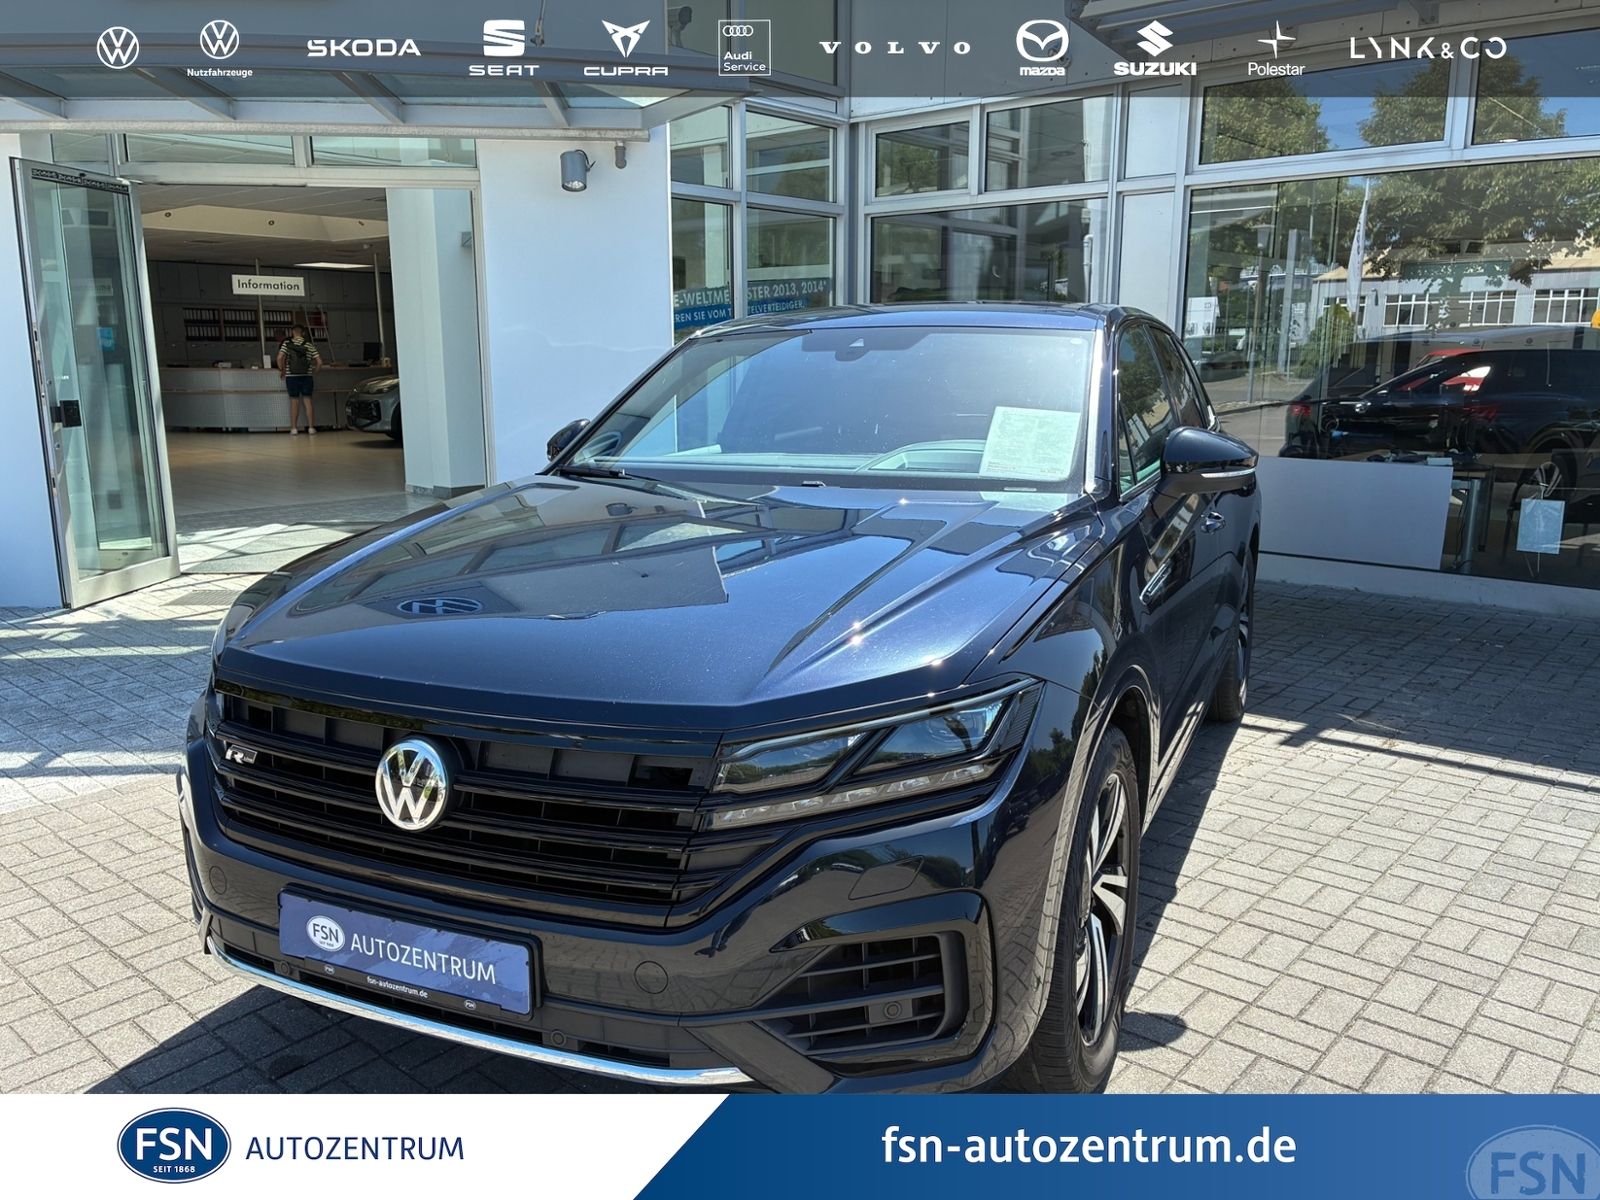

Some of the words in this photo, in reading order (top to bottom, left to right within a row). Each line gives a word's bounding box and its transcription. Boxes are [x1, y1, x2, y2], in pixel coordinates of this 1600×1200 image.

[237, 279, 300, 291] Information
[772, 283, 799, 298] 2013,
[693, 310, 706, 321] SIE
[706, 308, 726, 319] VOM
[312, 922, 340, 944] FSN
[350, 932, 497, 986] AUTOZENTRUM
[366, 975, 429, 999] fsn-autozentrum.de
